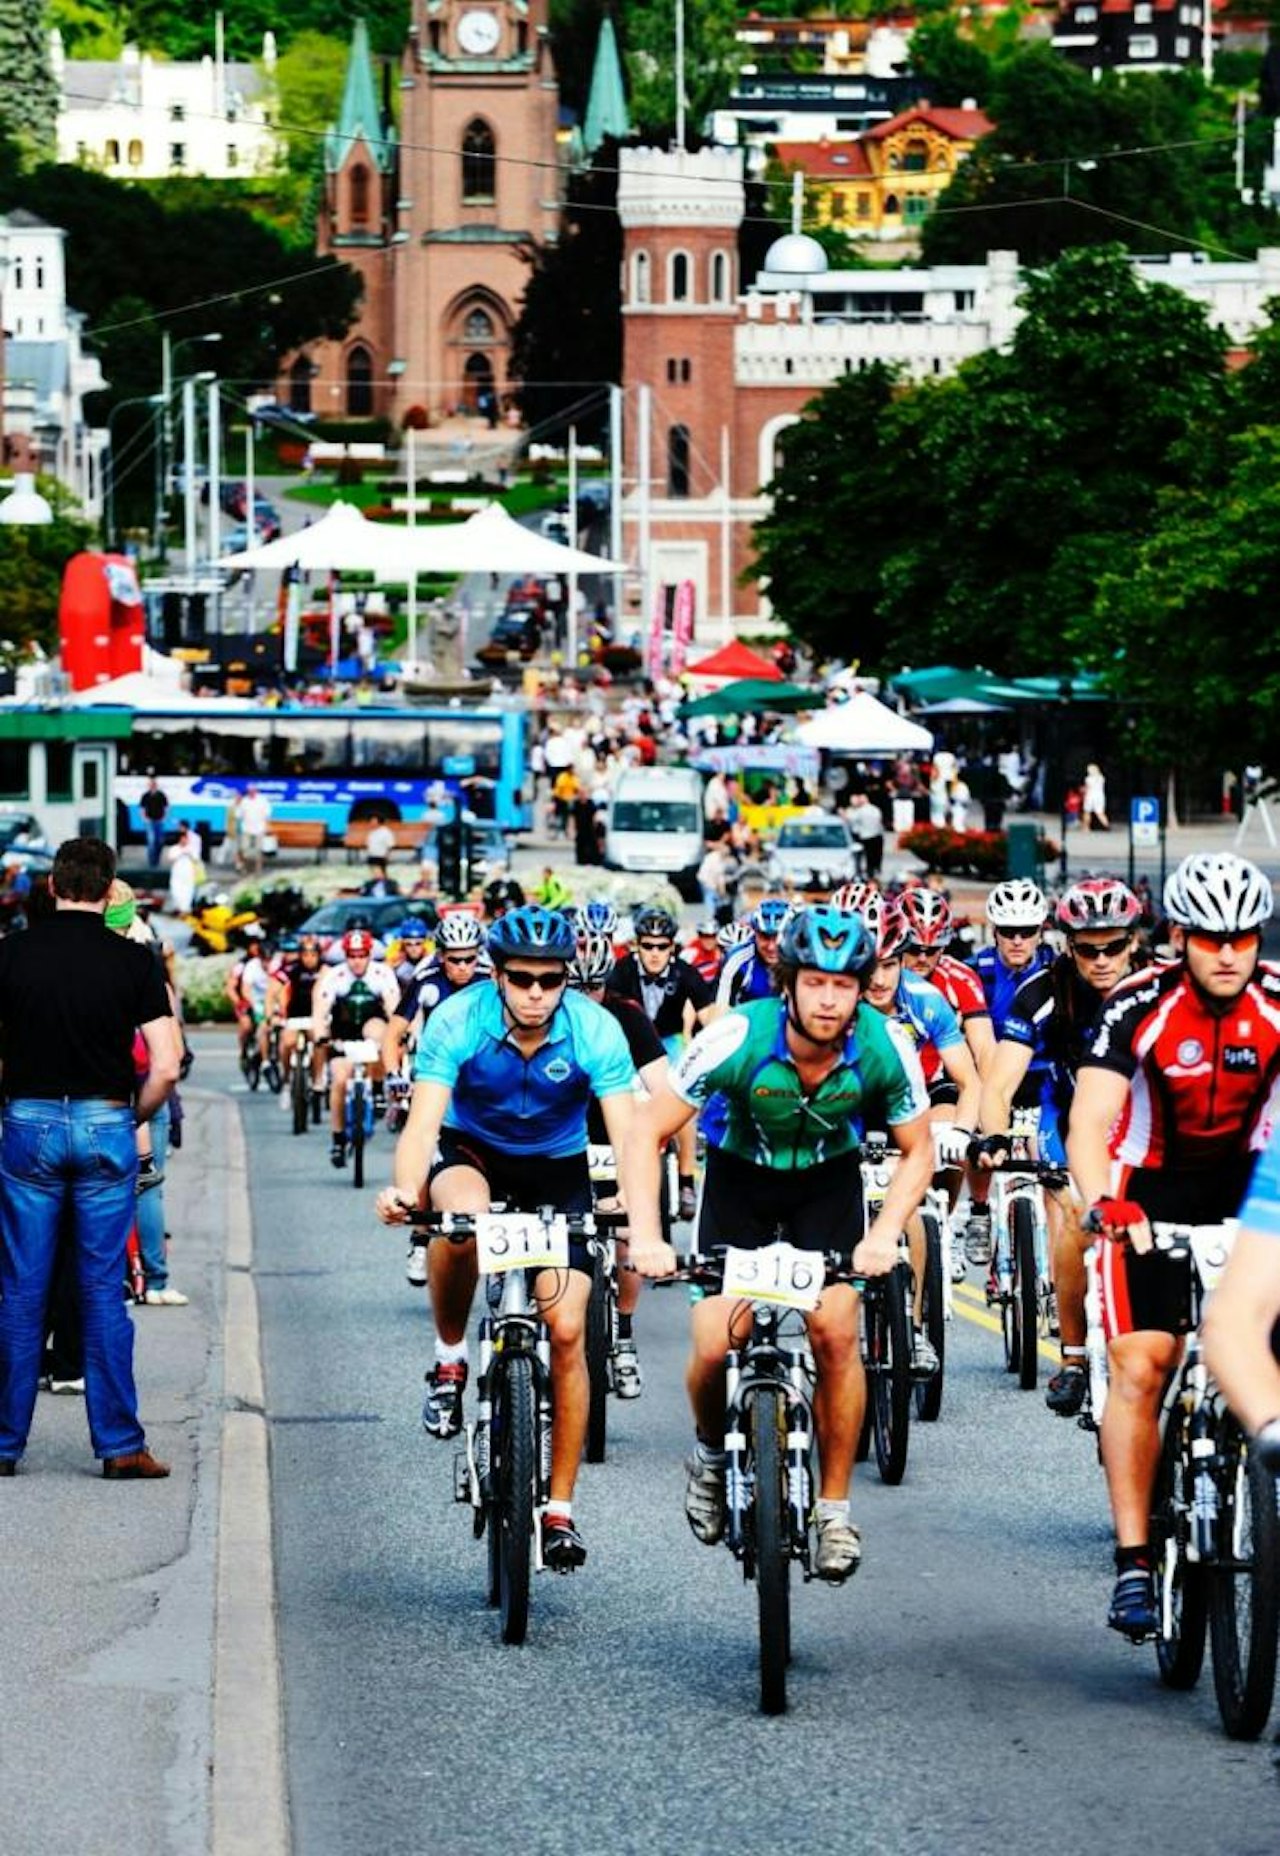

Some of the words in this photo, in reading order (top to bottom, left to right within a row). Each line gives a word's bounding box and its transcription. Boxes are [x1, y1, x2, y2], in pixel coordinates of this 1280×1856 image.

[1138, 800, 1154, 822] P
[489, 1224, 552, 1256] 311
[736, 1255, 813, 1290] 316
